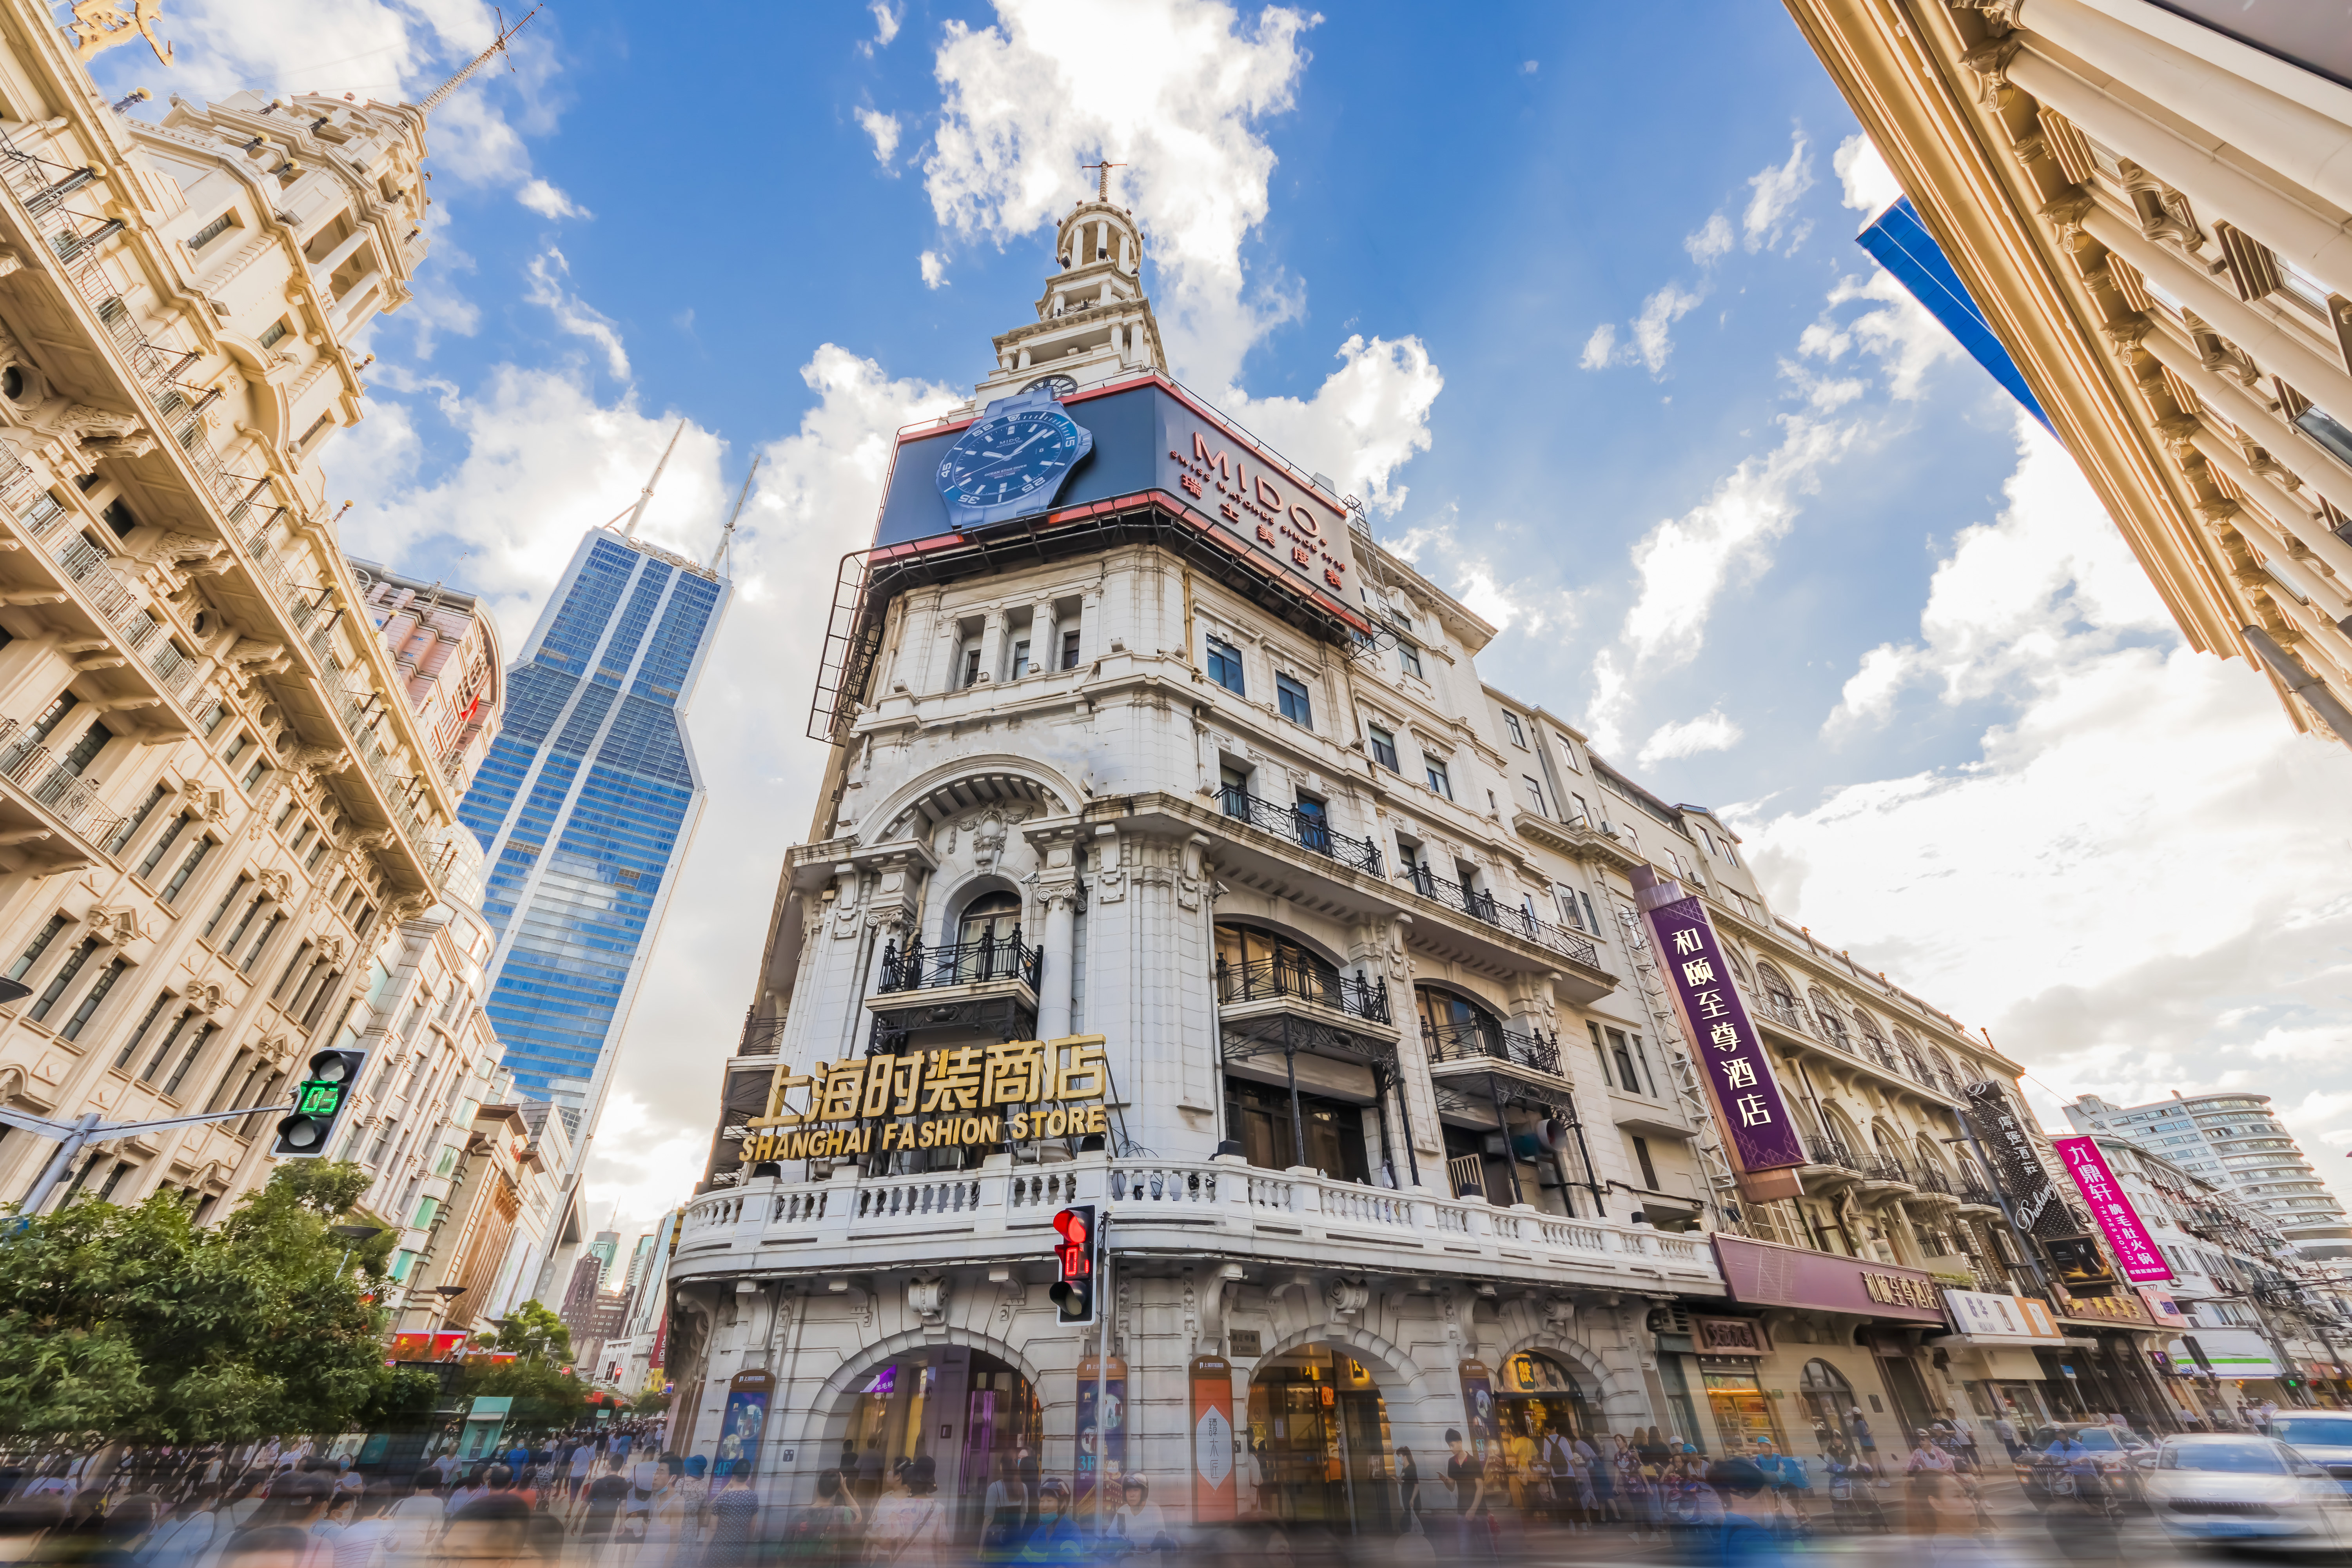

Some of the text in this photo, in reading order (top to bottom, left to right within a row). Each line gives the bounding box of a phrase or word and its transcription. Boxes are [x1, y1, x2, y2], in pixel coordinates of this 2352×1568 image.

[972, 423, 993, 437] 55
[1000, 437, 1020, 445] MIDO
[1065, 436, 1075, 447] 15
[941, 462, 952, 478] 45
[1022, 477, 1045, 493] 25
[1193, 432, 1320, 537] MIDO
[958, 494, 980, 504] 35
[1170, 450, 1210, 481] SWISS
[1217, 481, 1275, 525] WATCHES
[1280, 525, 1318, 553] SINCE
[1181, 473, 1342, 590] 瑞士美度表
[1671, 927, 1771, 1128] 和颐至尊酒店
[747, 1033, 1106, 1129] 上海时装商店
[739, 1105, 1107, 1163] SHANGHAI FASHION STORE
[2068, 1146, 2112, 1202] 九鼎轩
[2099, 1205, 2137, 1265] TRIPES HOTPOT
[2107, 1203, 2155, 1265] 脆毛肚火锅
[1860, 1271, 1940, 1310] 和颐至尊酒店
[876, 1381, 893, 1391] 羊毛衫
[714, 1462, 731, 1476] 4F
[1078, 1455, 1096, 1471] 3F
